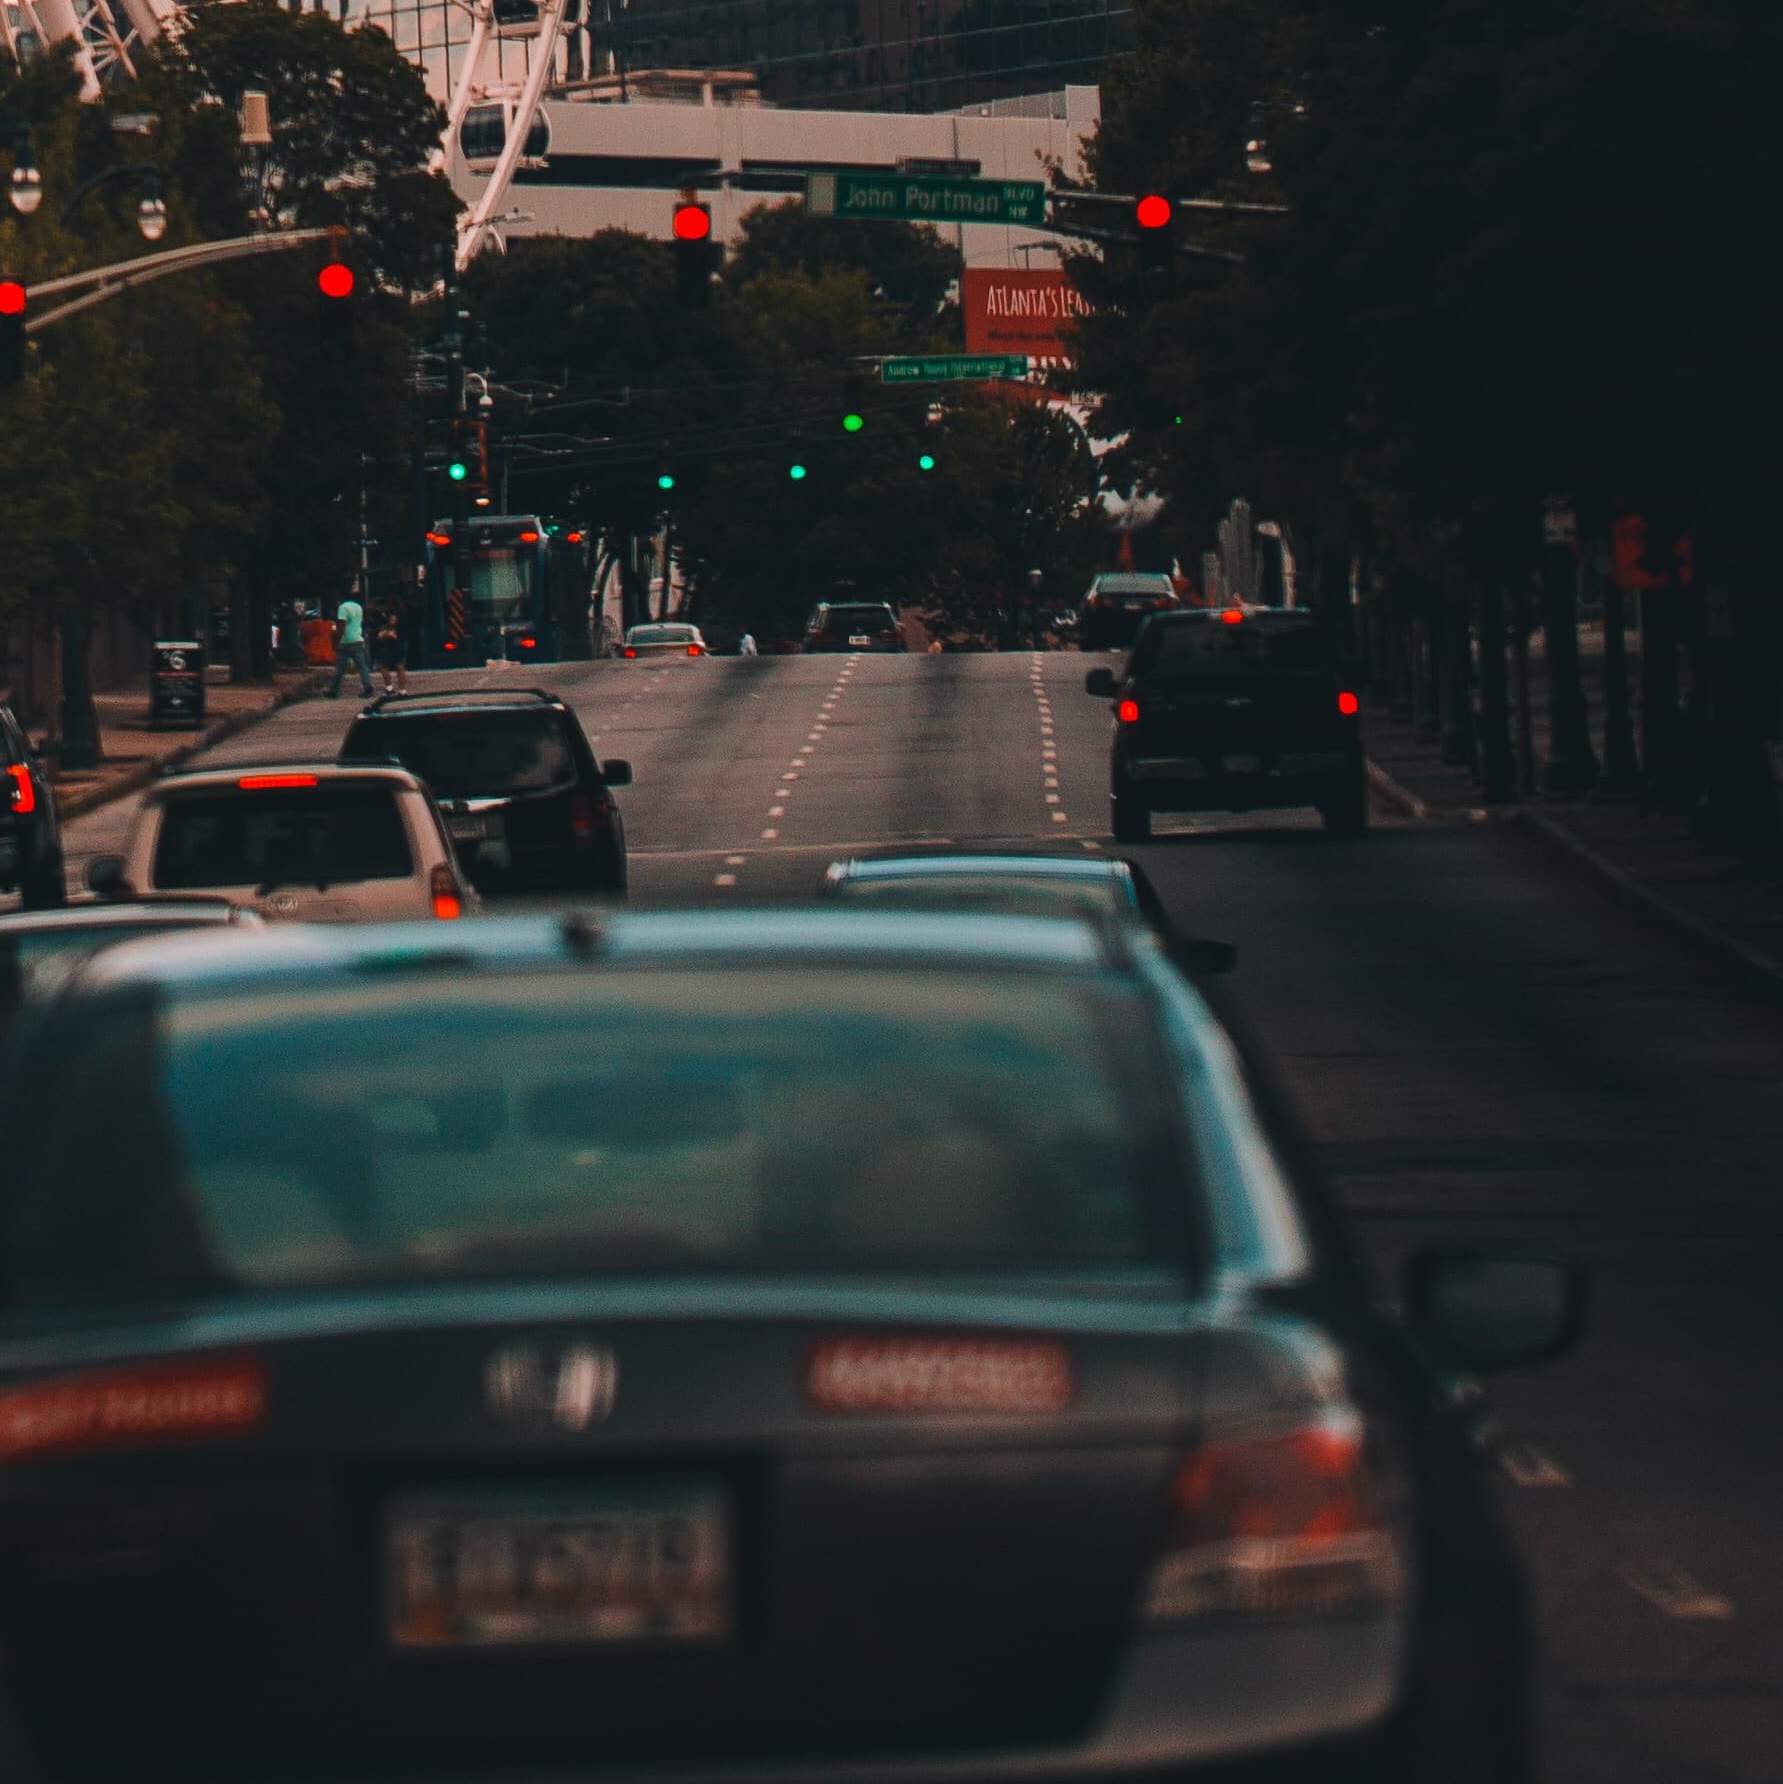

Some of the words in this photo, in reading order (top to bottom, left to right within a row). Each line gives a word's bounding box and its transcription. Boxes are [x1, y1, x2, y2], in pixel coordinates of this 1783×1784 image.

[843, 183, 894, 210] John
[905, 185, 999, 214] Portman
[1004, 185, 1035, 201] BLVD
[987, 285, 1058, 317] ATLANTA'S
